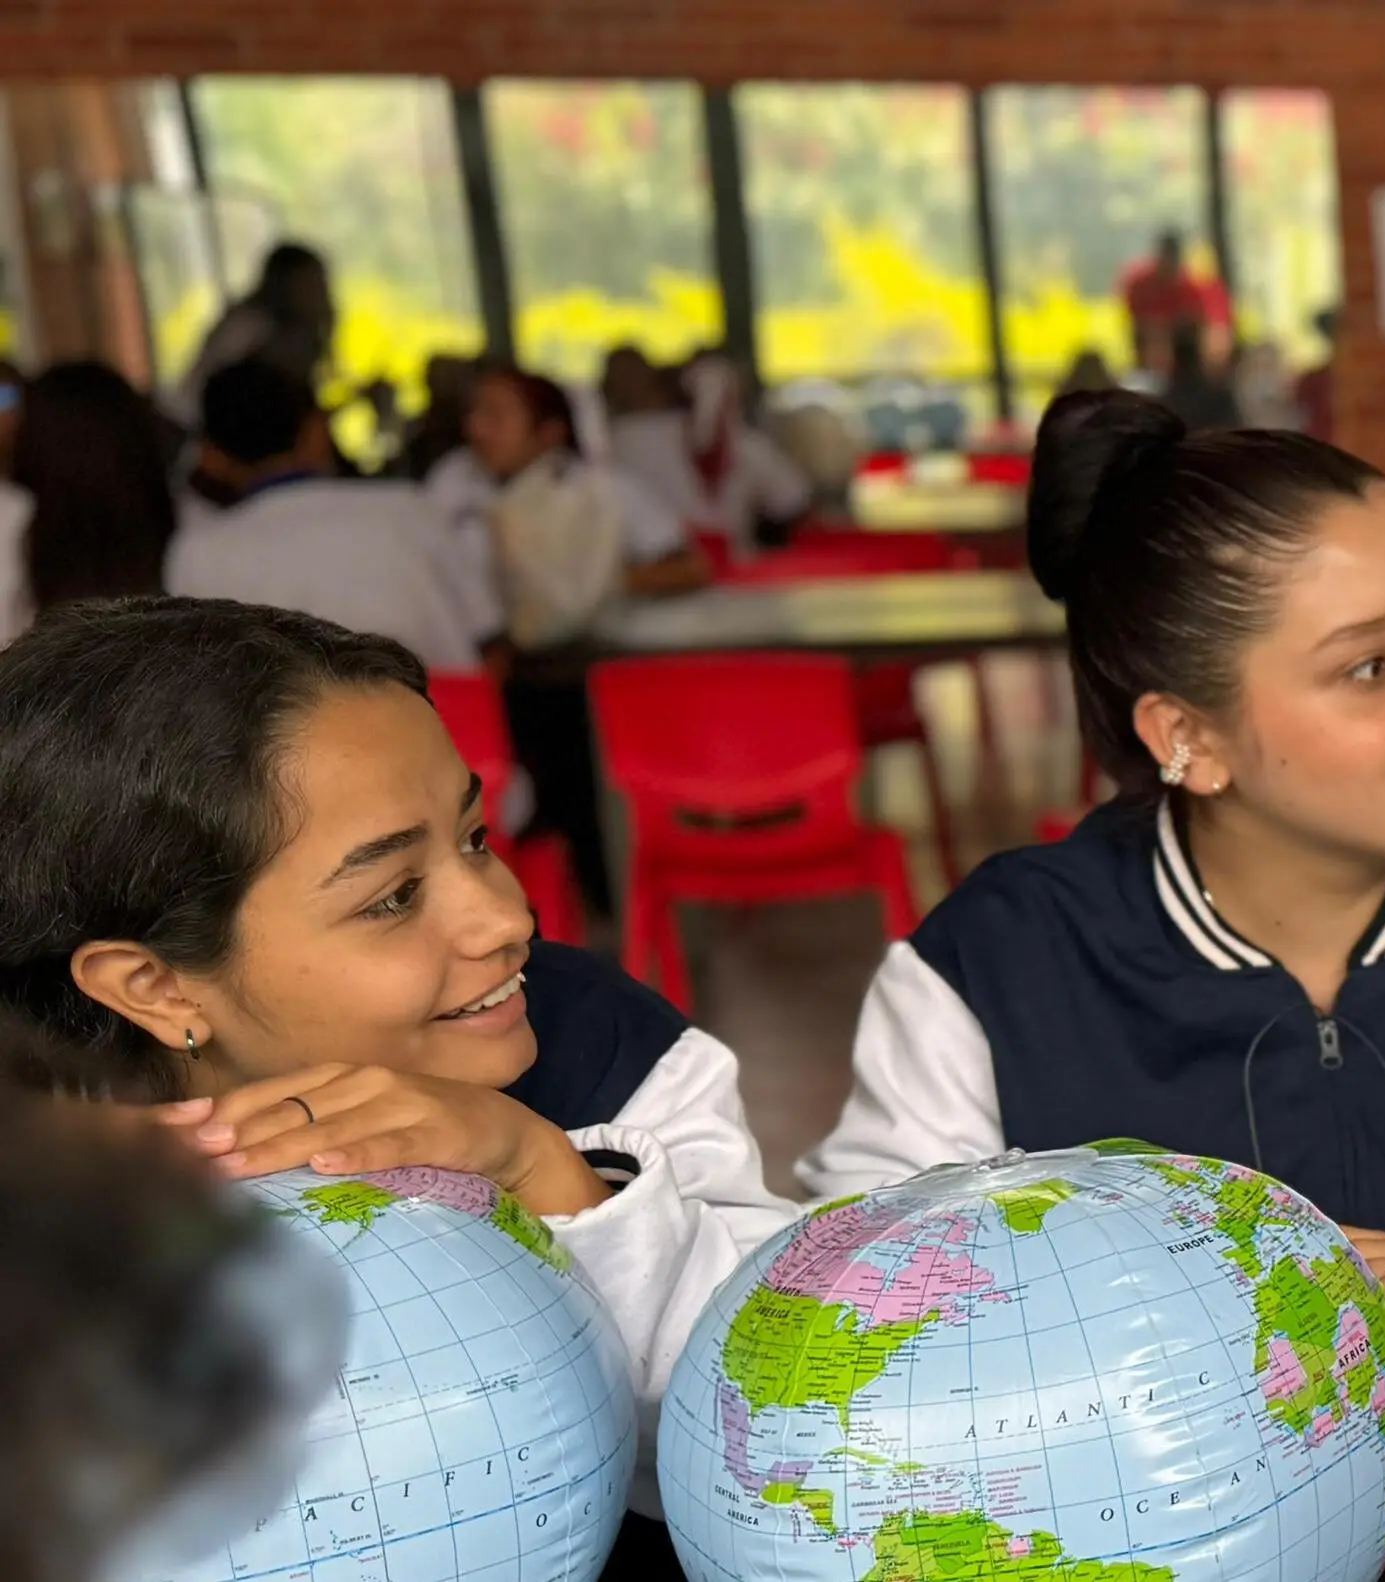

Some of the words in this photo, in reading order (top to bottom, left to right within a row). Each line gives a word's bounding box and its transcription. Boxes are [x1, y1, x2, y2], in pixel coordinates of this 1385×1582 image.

[1167, 1234, 1215, 1254] EUROPE
[1337, 1338, 1372, 1368] AFRICA
[714, 1485, 740, 1503] CENTRAL
[727, 1508, 759, 1526] AMERICA
